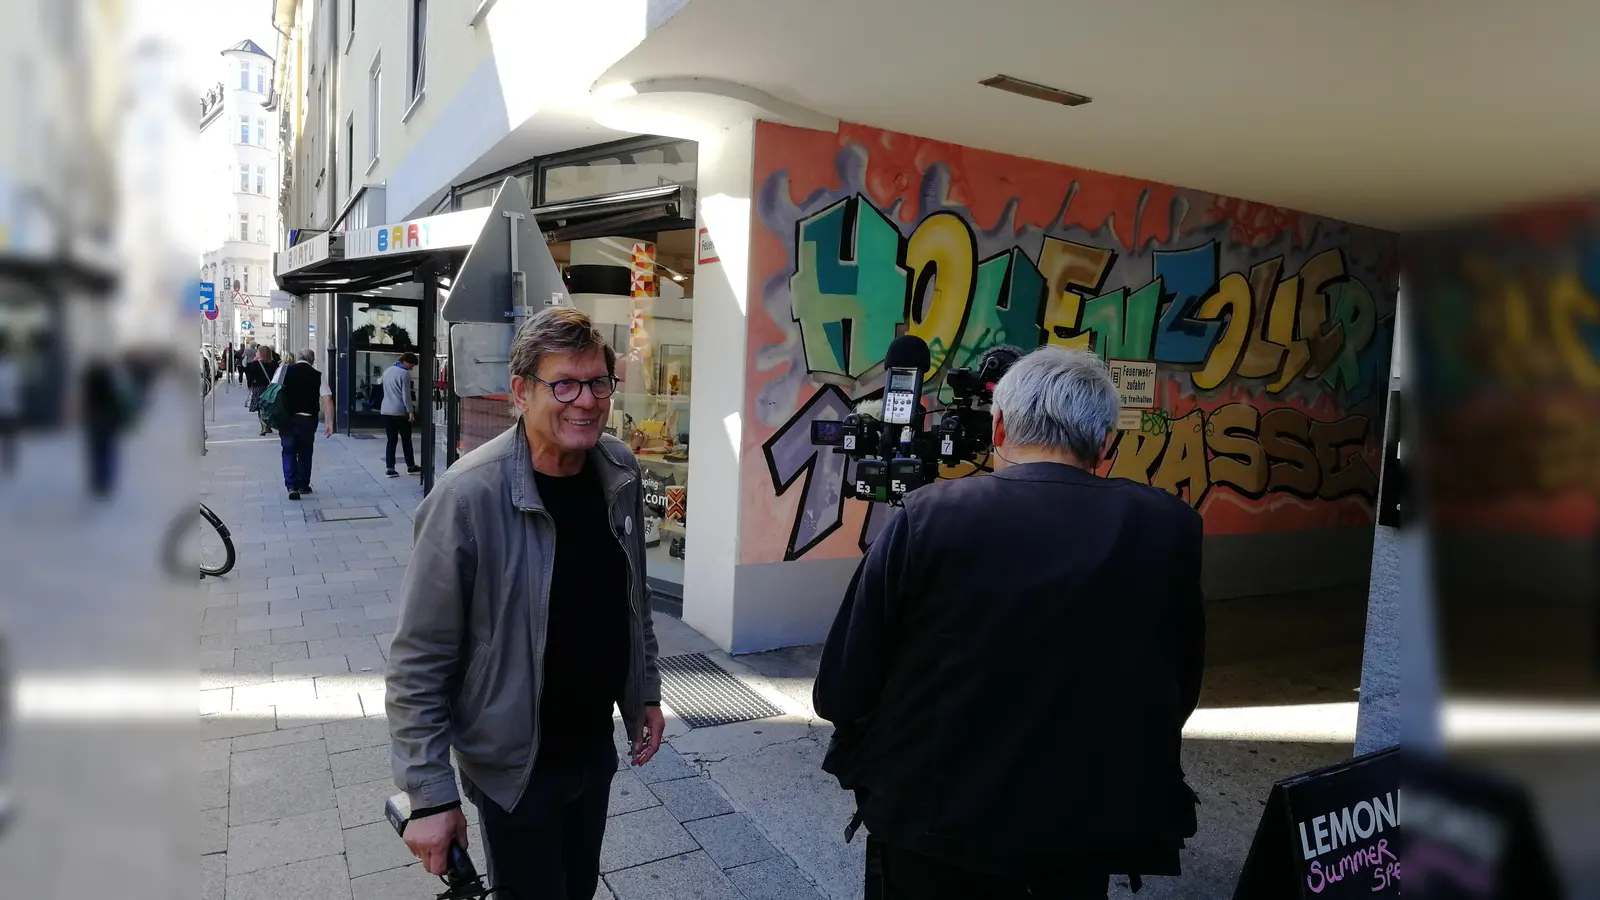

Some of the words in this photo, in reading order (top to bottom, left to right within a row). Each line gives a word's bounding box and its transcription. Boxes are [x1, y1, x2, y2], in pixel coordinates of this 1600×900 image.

[1123, 365, 1153, 378] Feuerwehr-
[1126, 379, 1146, 391] zufahrt
[1128, 395, 1153, 404] freihalten
[846, 437, 853, 449] 2
[943, 442, 951, 453] 7
[856, 480, 871, 493] E3
[892, 479, 906, 492] E5
[1298, 788, 1400, 861] LEMON
